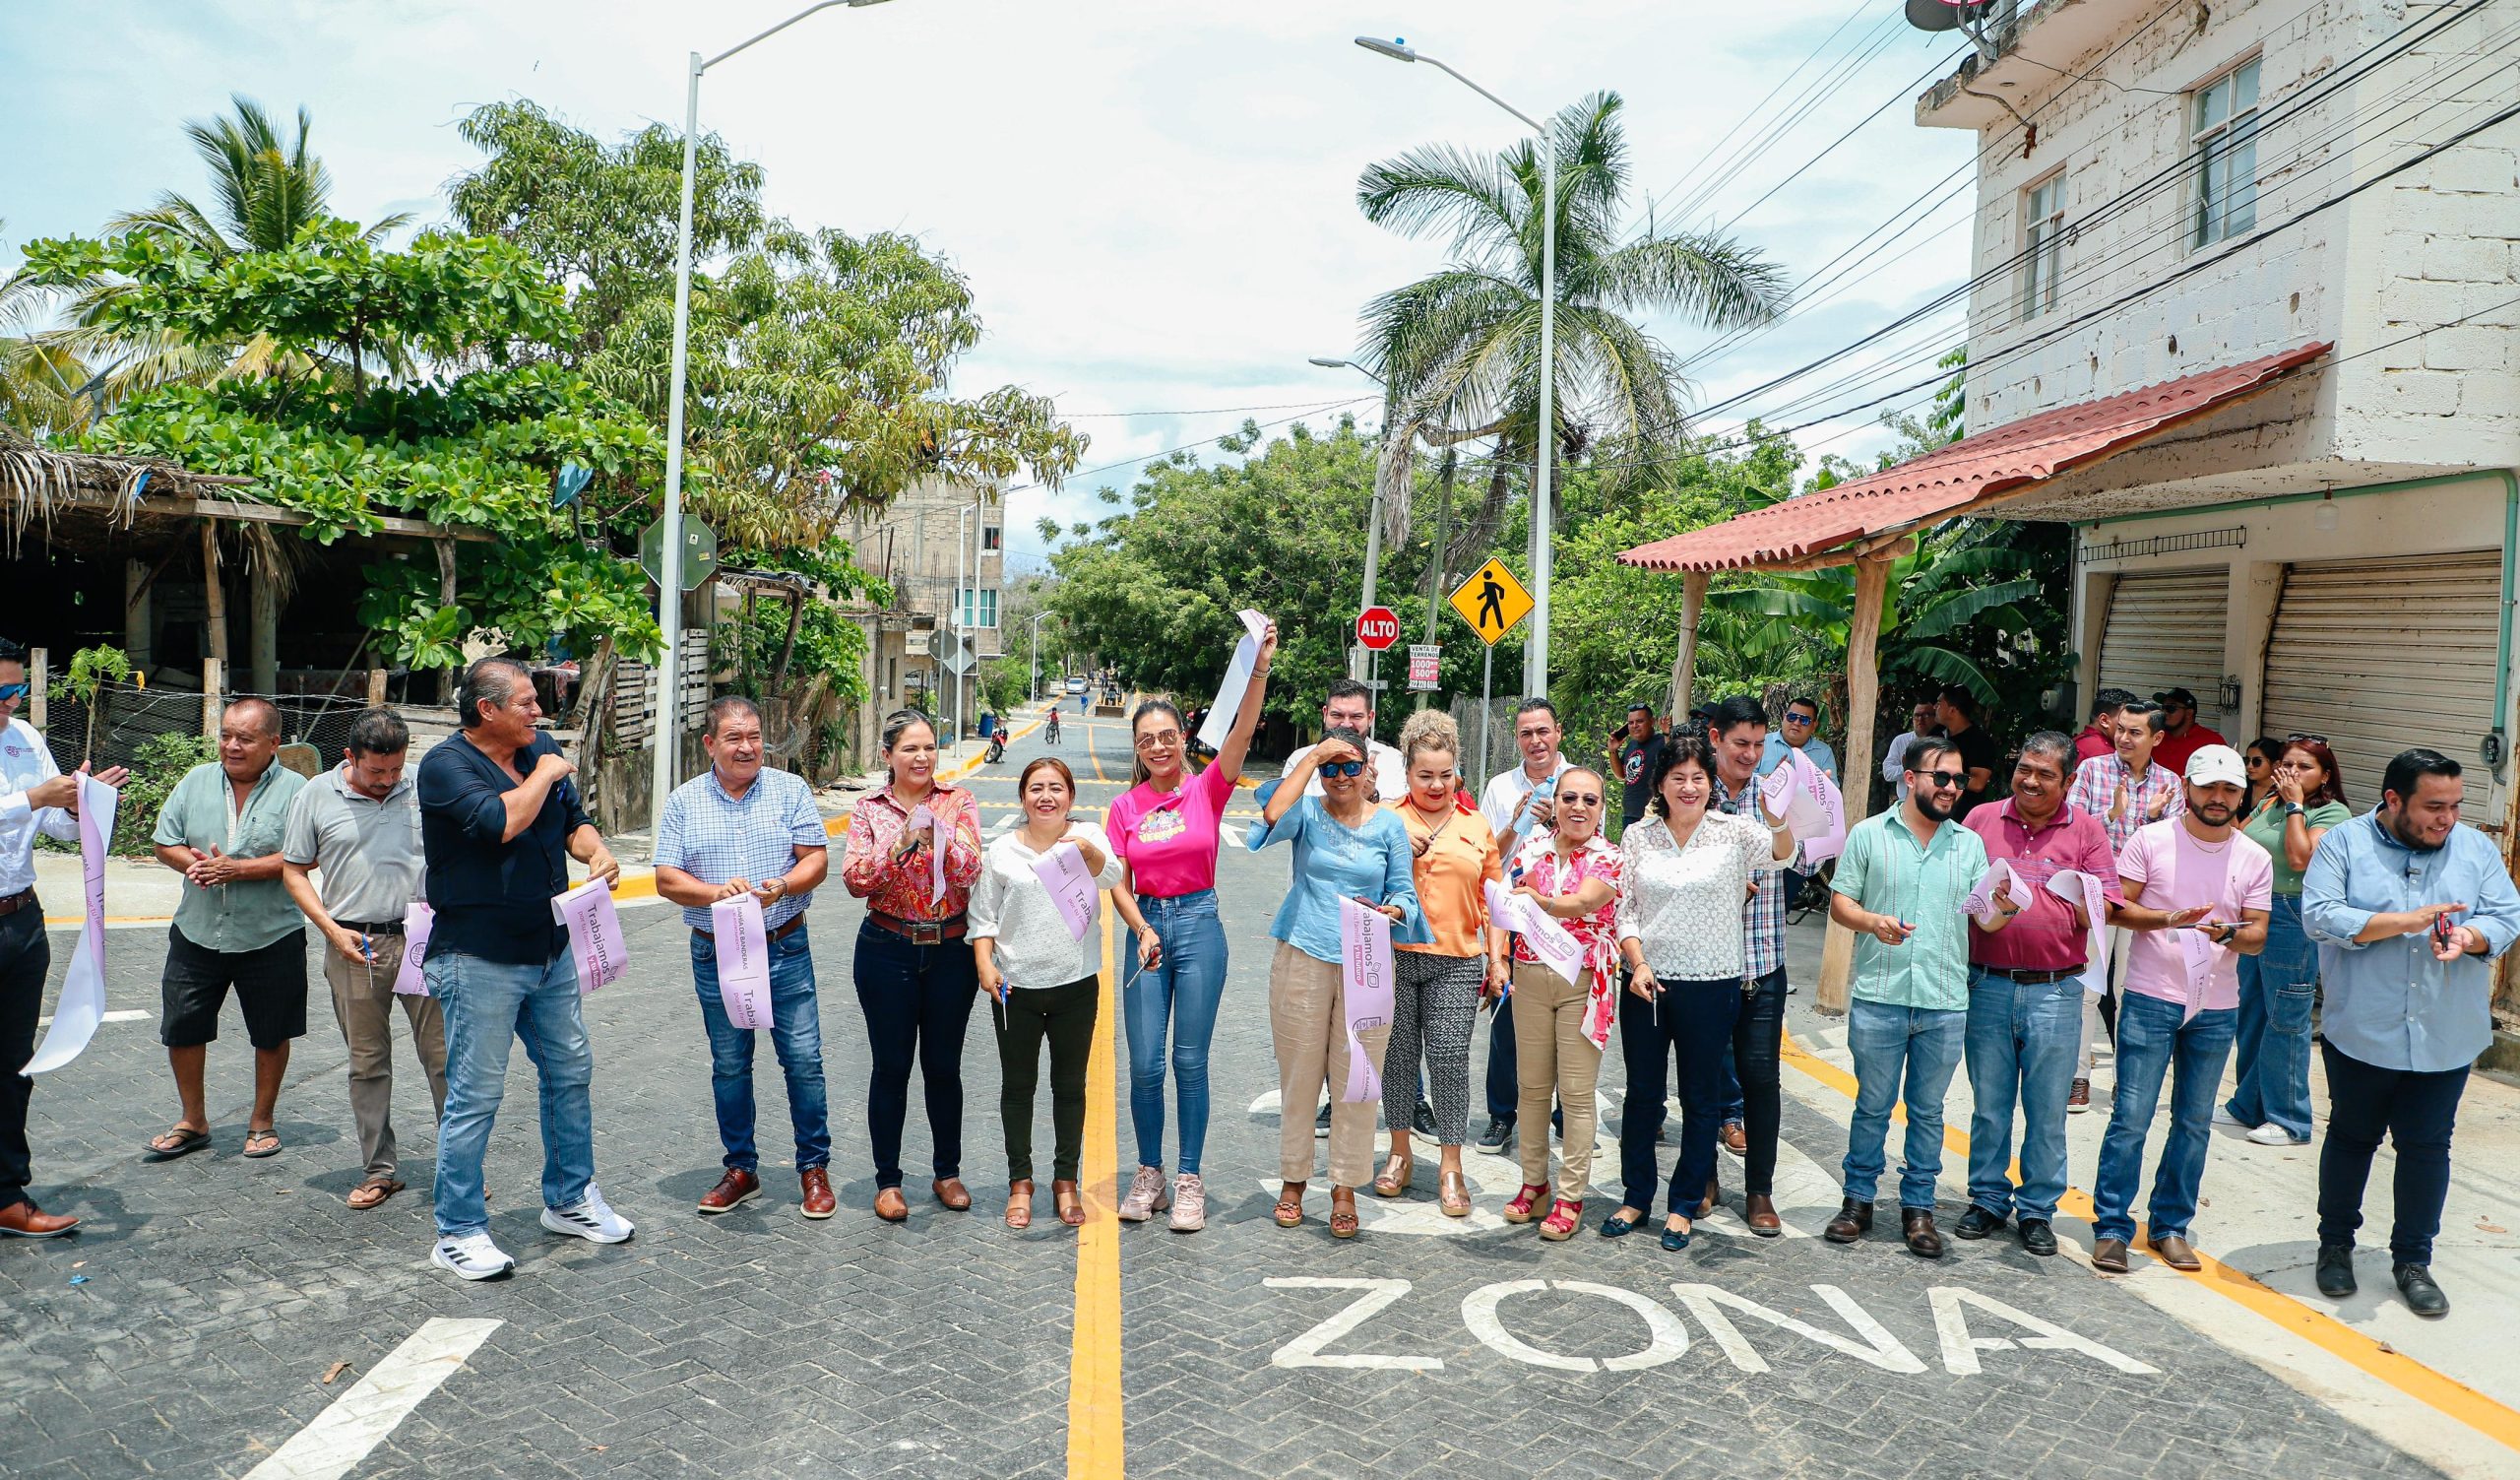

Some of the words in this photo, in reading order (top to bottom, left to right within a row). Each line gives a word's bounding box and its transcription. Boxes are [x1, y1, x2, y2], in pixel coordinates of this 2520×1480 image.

[1360, 619, 1396, 638] ALTO
[1411, 660, 1430, 669] 1000
[1416, 669, 1430, 677] 500
[582, 922, 588, 933] tu
[739, 927, 745, 936] DE
[588, 903, 610, 975] Trabajamos
[1362, 906, 1374, 967] rabajamos
[583, 932, 593, 955] familia
[1355, 951, 1360, 960] tu
[591, 961, 598, 971] tu
[1263, 1276, 2163, 1377] ZONA
